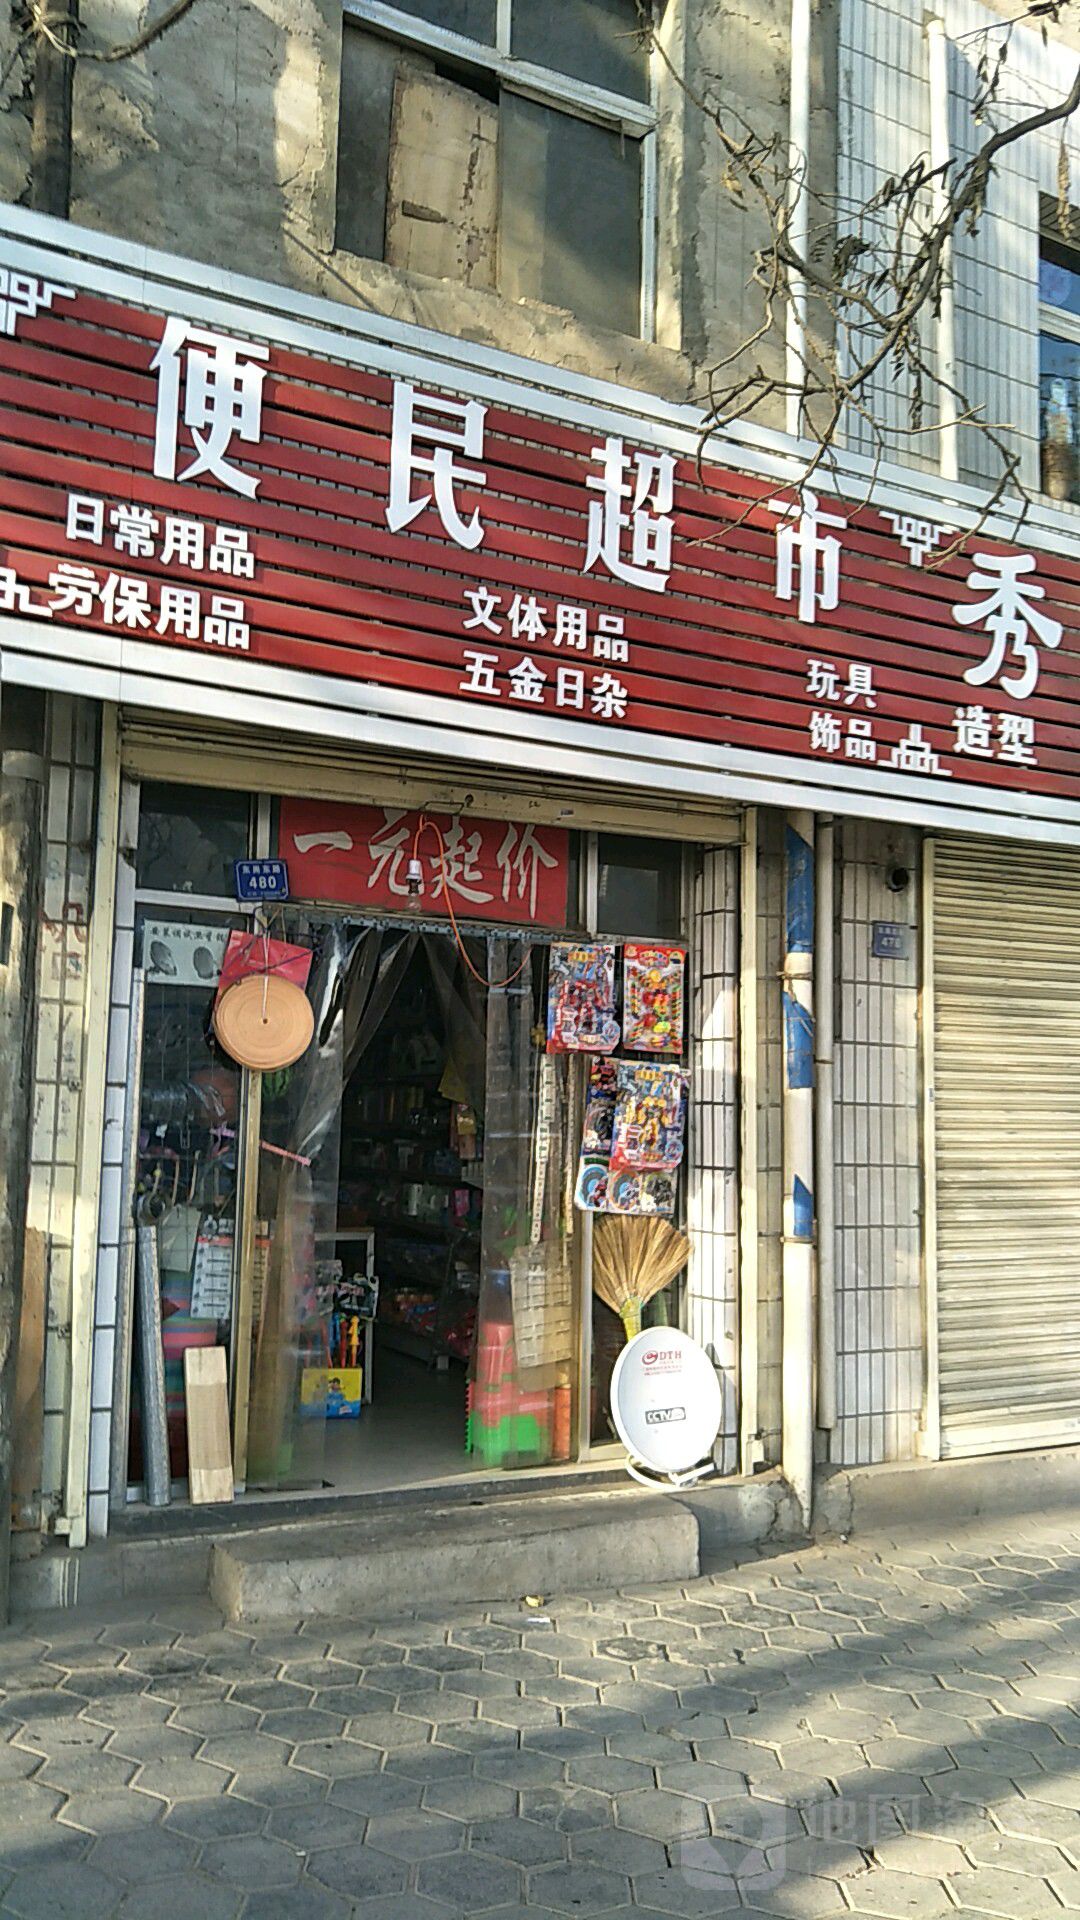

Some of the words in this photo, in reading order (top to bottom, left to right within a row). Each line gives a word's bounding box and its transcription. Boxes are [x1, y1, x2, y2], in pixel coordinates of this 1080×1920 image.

[149, 316, 853, 624] 便民超市
[66, 493, 255, 579] 日常用品
[48, 563, 251, 650] 劳保用品
[462, 586, 629, 663] 文体用品
[952, 552, 1064, 699] 秀
[459, 650, 628, 718] 五金日杂
[806, 659, 878, 708] 玩具
[808, 711, 877, 761] 饰品
[952, 705, 1038, 765] 造型
[249, 875, 277, 889] 480
[293, 808, 559, 919] 一元起价
[659, 1350, 682, 1361] DTH
